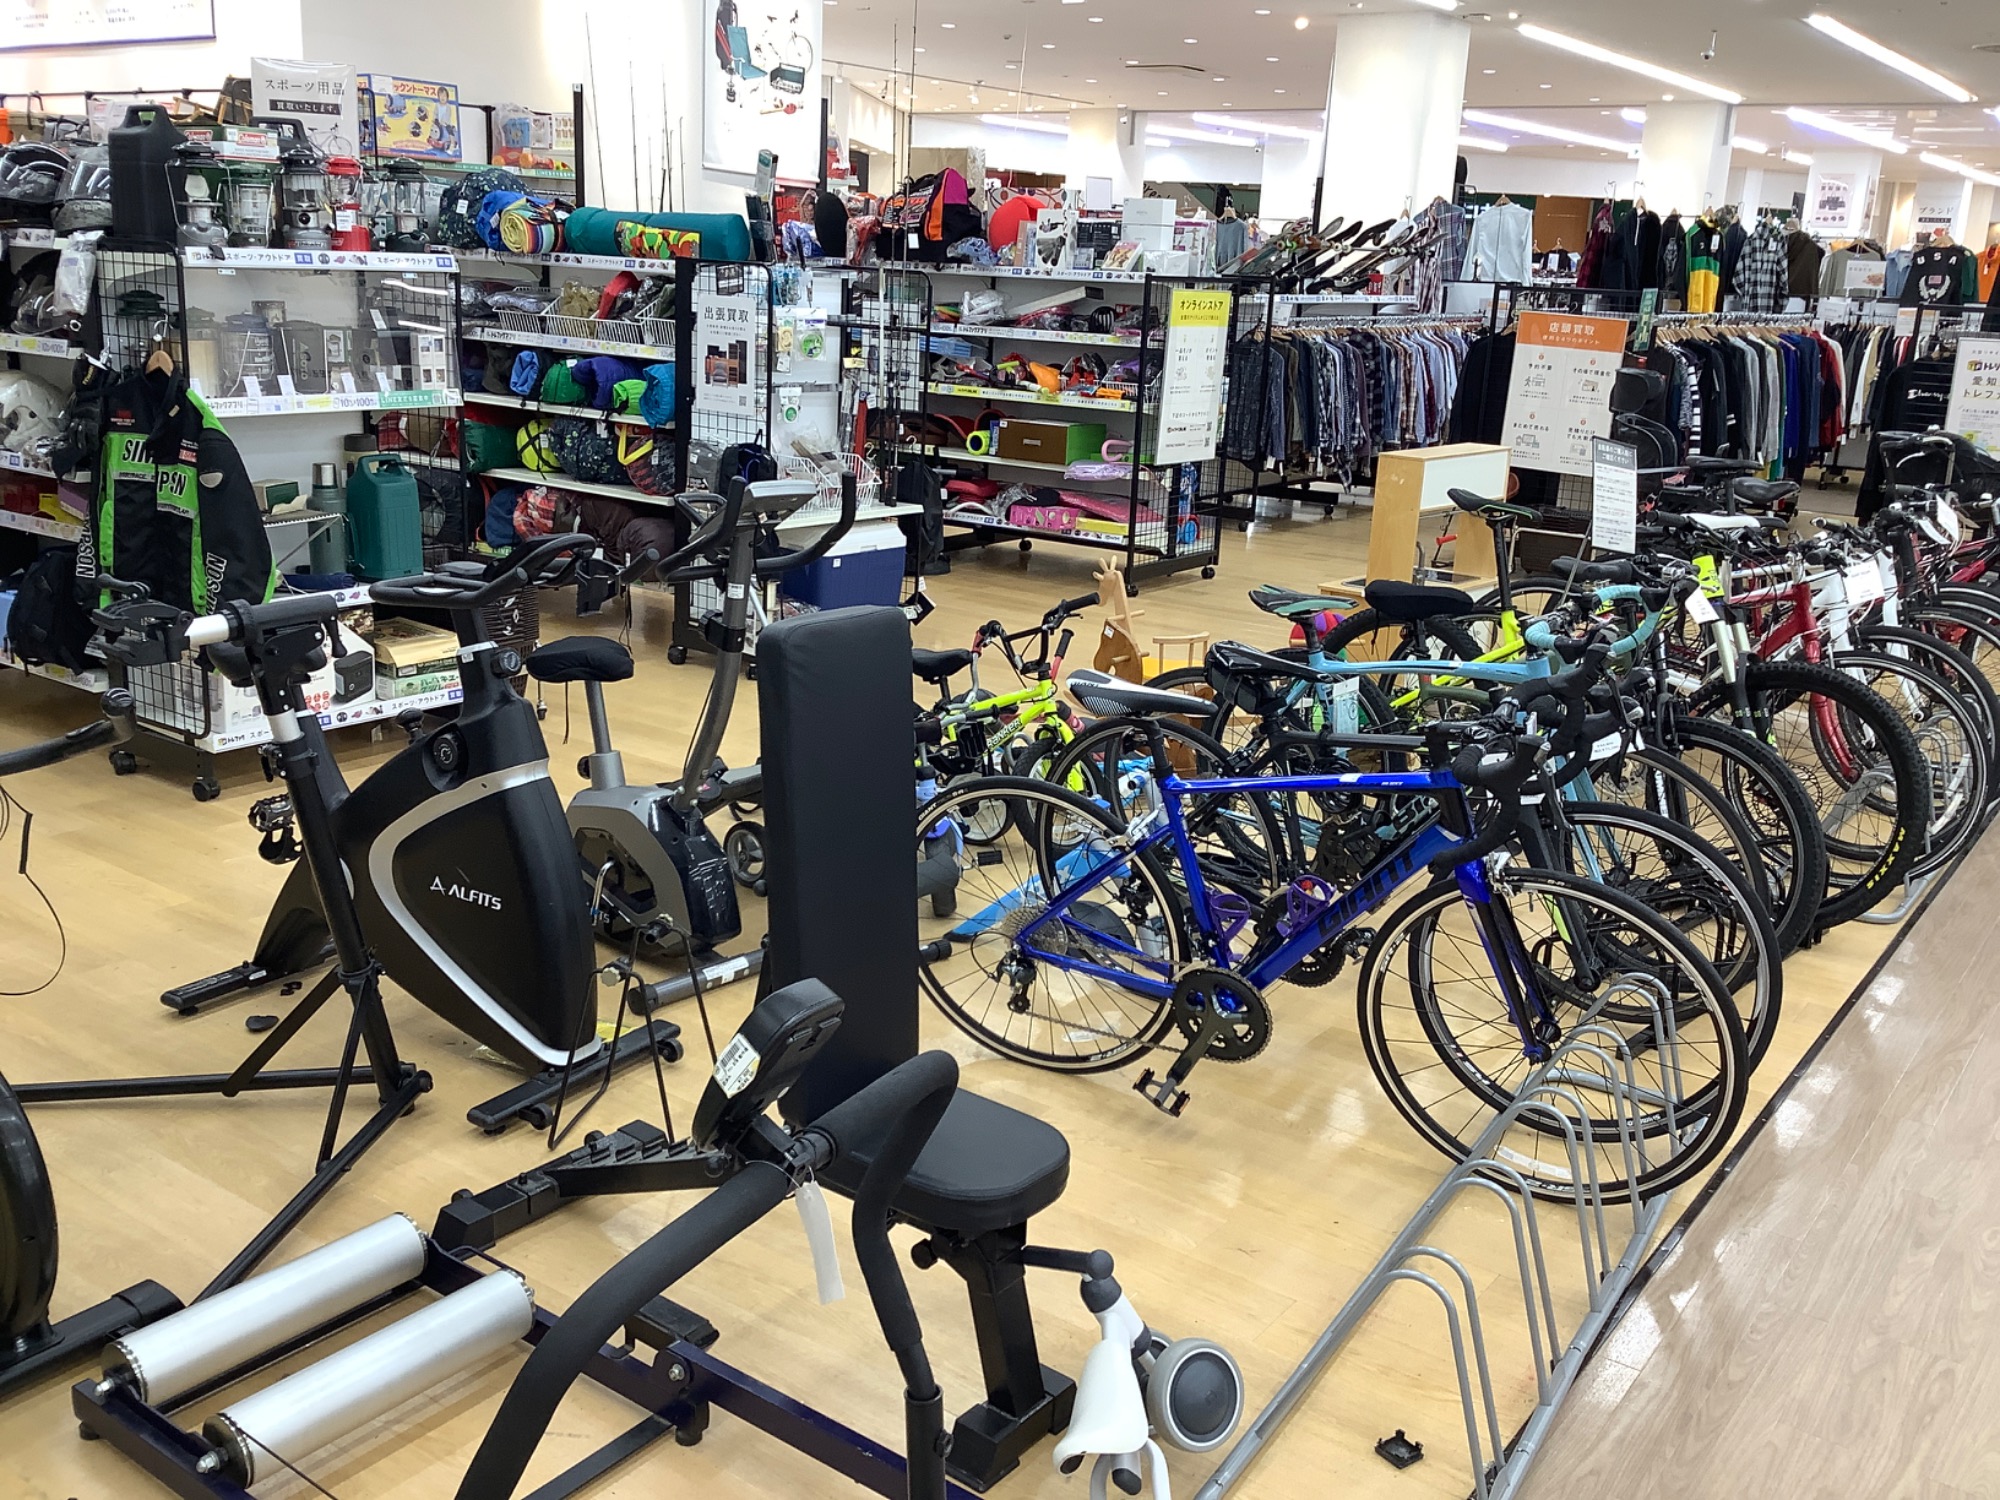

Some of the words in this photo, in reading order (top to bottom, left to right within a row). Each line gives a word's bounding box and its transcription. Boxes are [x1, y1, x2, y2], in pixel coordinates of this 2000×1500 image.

[265, 79, 345, 96] スポーツ用品
[1917, 252, 1957, 265] USA
[1180, 299, 1224, 311] オンラインストア
[704, 305, 749, 323] 出張買取
[1548, 321, 1595, 336] 店頭買取
[1972, 376, 1997, 386] 愛知
[1963, 389, 2000, 399] トレフ
[1866, 826, 1906, 890] MAXXIS
[448, 883, 502, 911] ALFITS
[1318, 850, 1414, 938] GIANT
